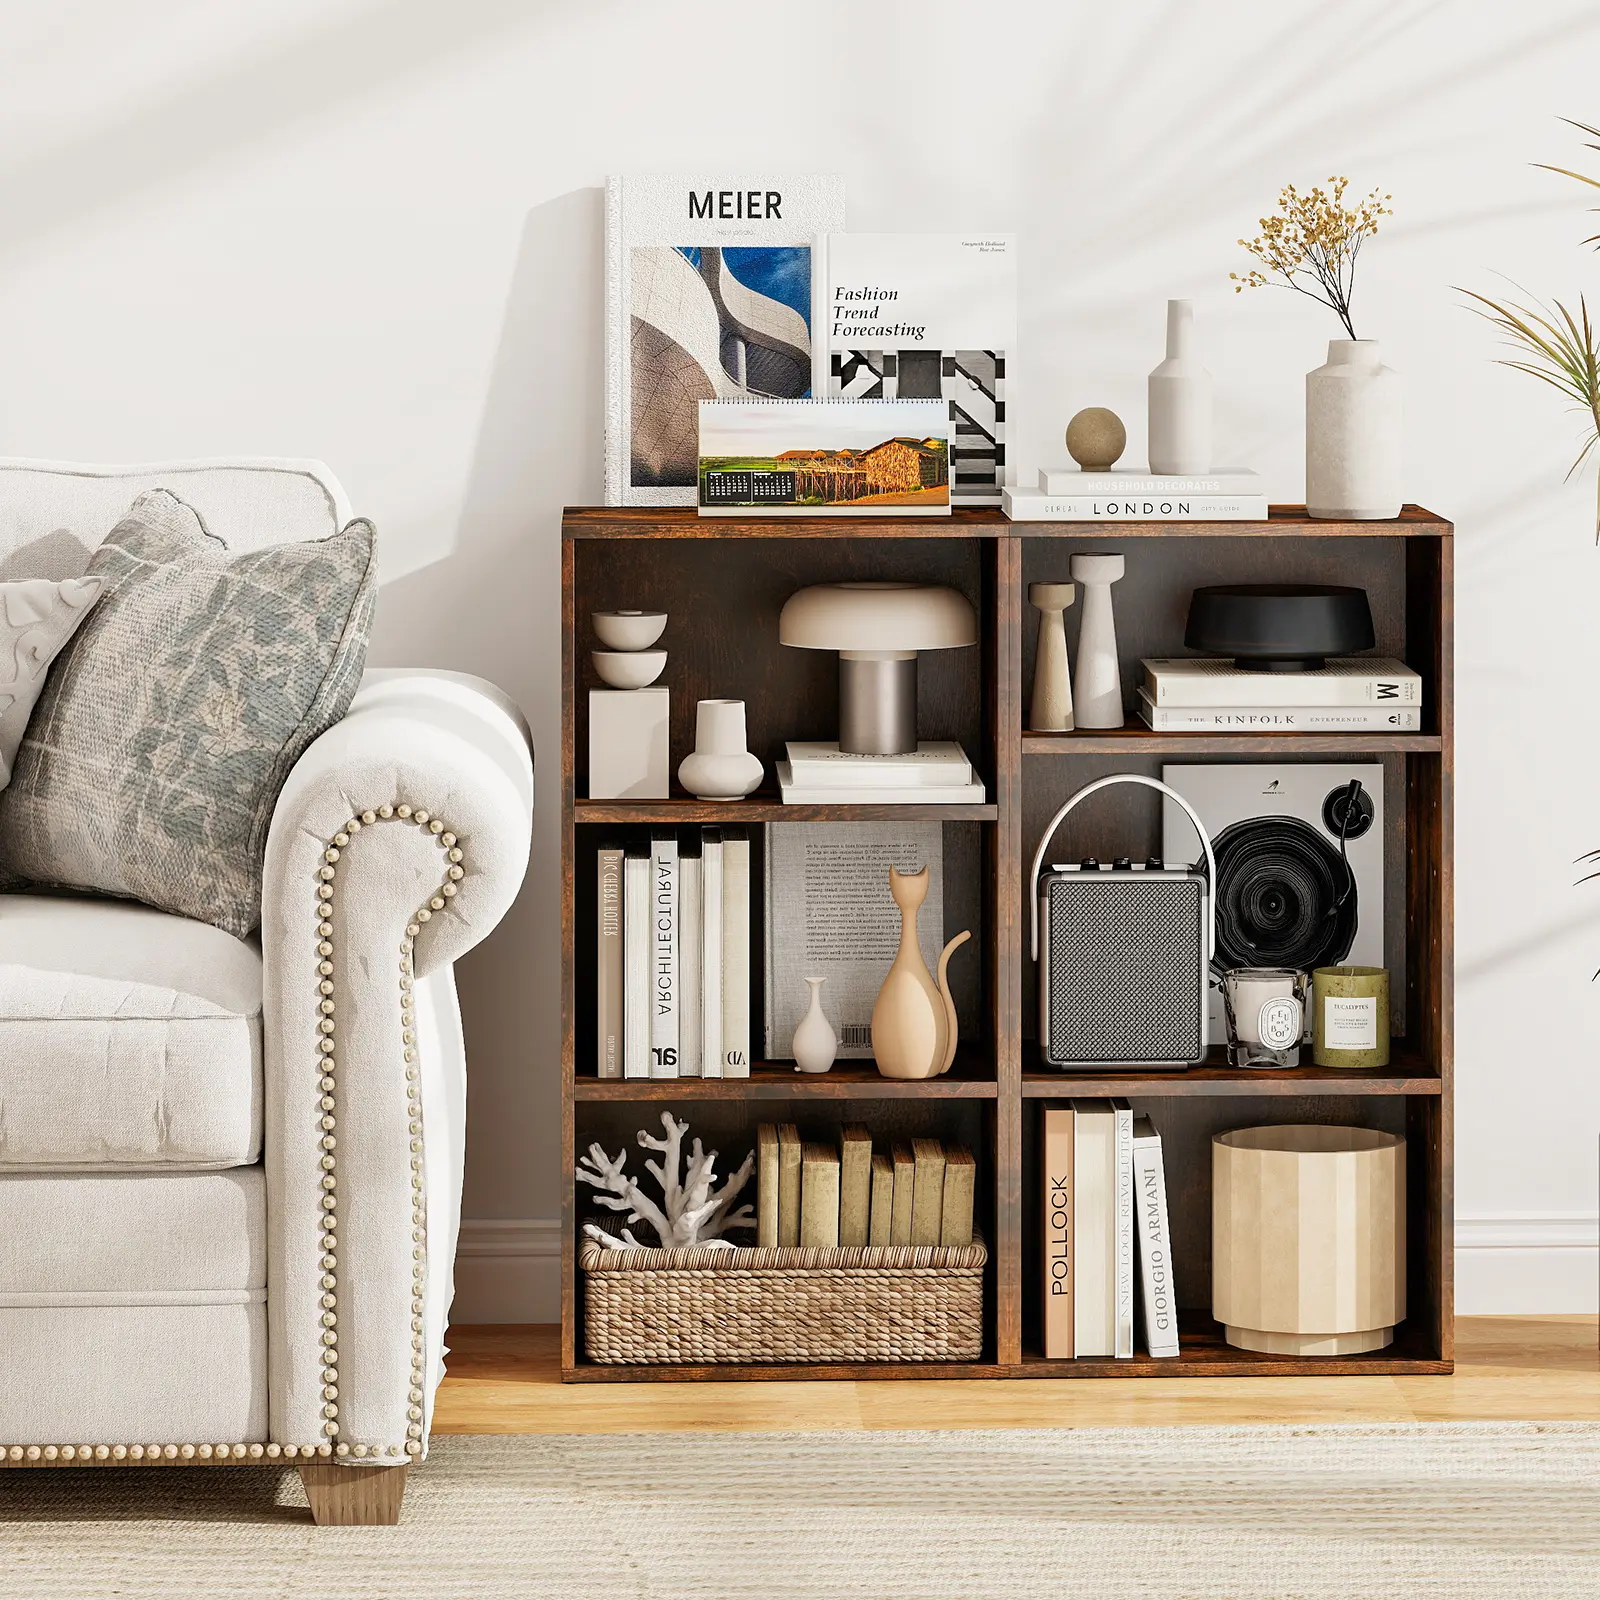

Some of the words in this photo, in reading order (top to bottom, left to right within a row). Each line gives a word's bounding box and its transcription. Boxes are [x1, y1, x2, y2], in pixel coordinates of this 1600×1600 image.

[689, 191, 782, 219] MEIER
[834, 286, 899, 301] Fashion
[833, 305, 879, 318] Trend
[832, 323, 926, 341] Forecasting
[1088, 481, 1154, 491] HOUSEHOLD
[1157, 481, 1220, 491] DECORATES
[1094, 502, 1190, 515] LONDON
[1377, 683, 1399, 700] M
[1214, 715, 1295, 724] KINFOLK
[1122, 1117, 1130, 1217] REVOLUTION
[1144, 1167, 1160, 1244] ARMANI
[1051, 1175, 1068, 1296] POLLOCK
[1122, 1223, 1130, 1268] LOOK
[1122, 1273, 1130, 1306] NEW
[1151, 1250, 1168, 1330] GIORGIO
